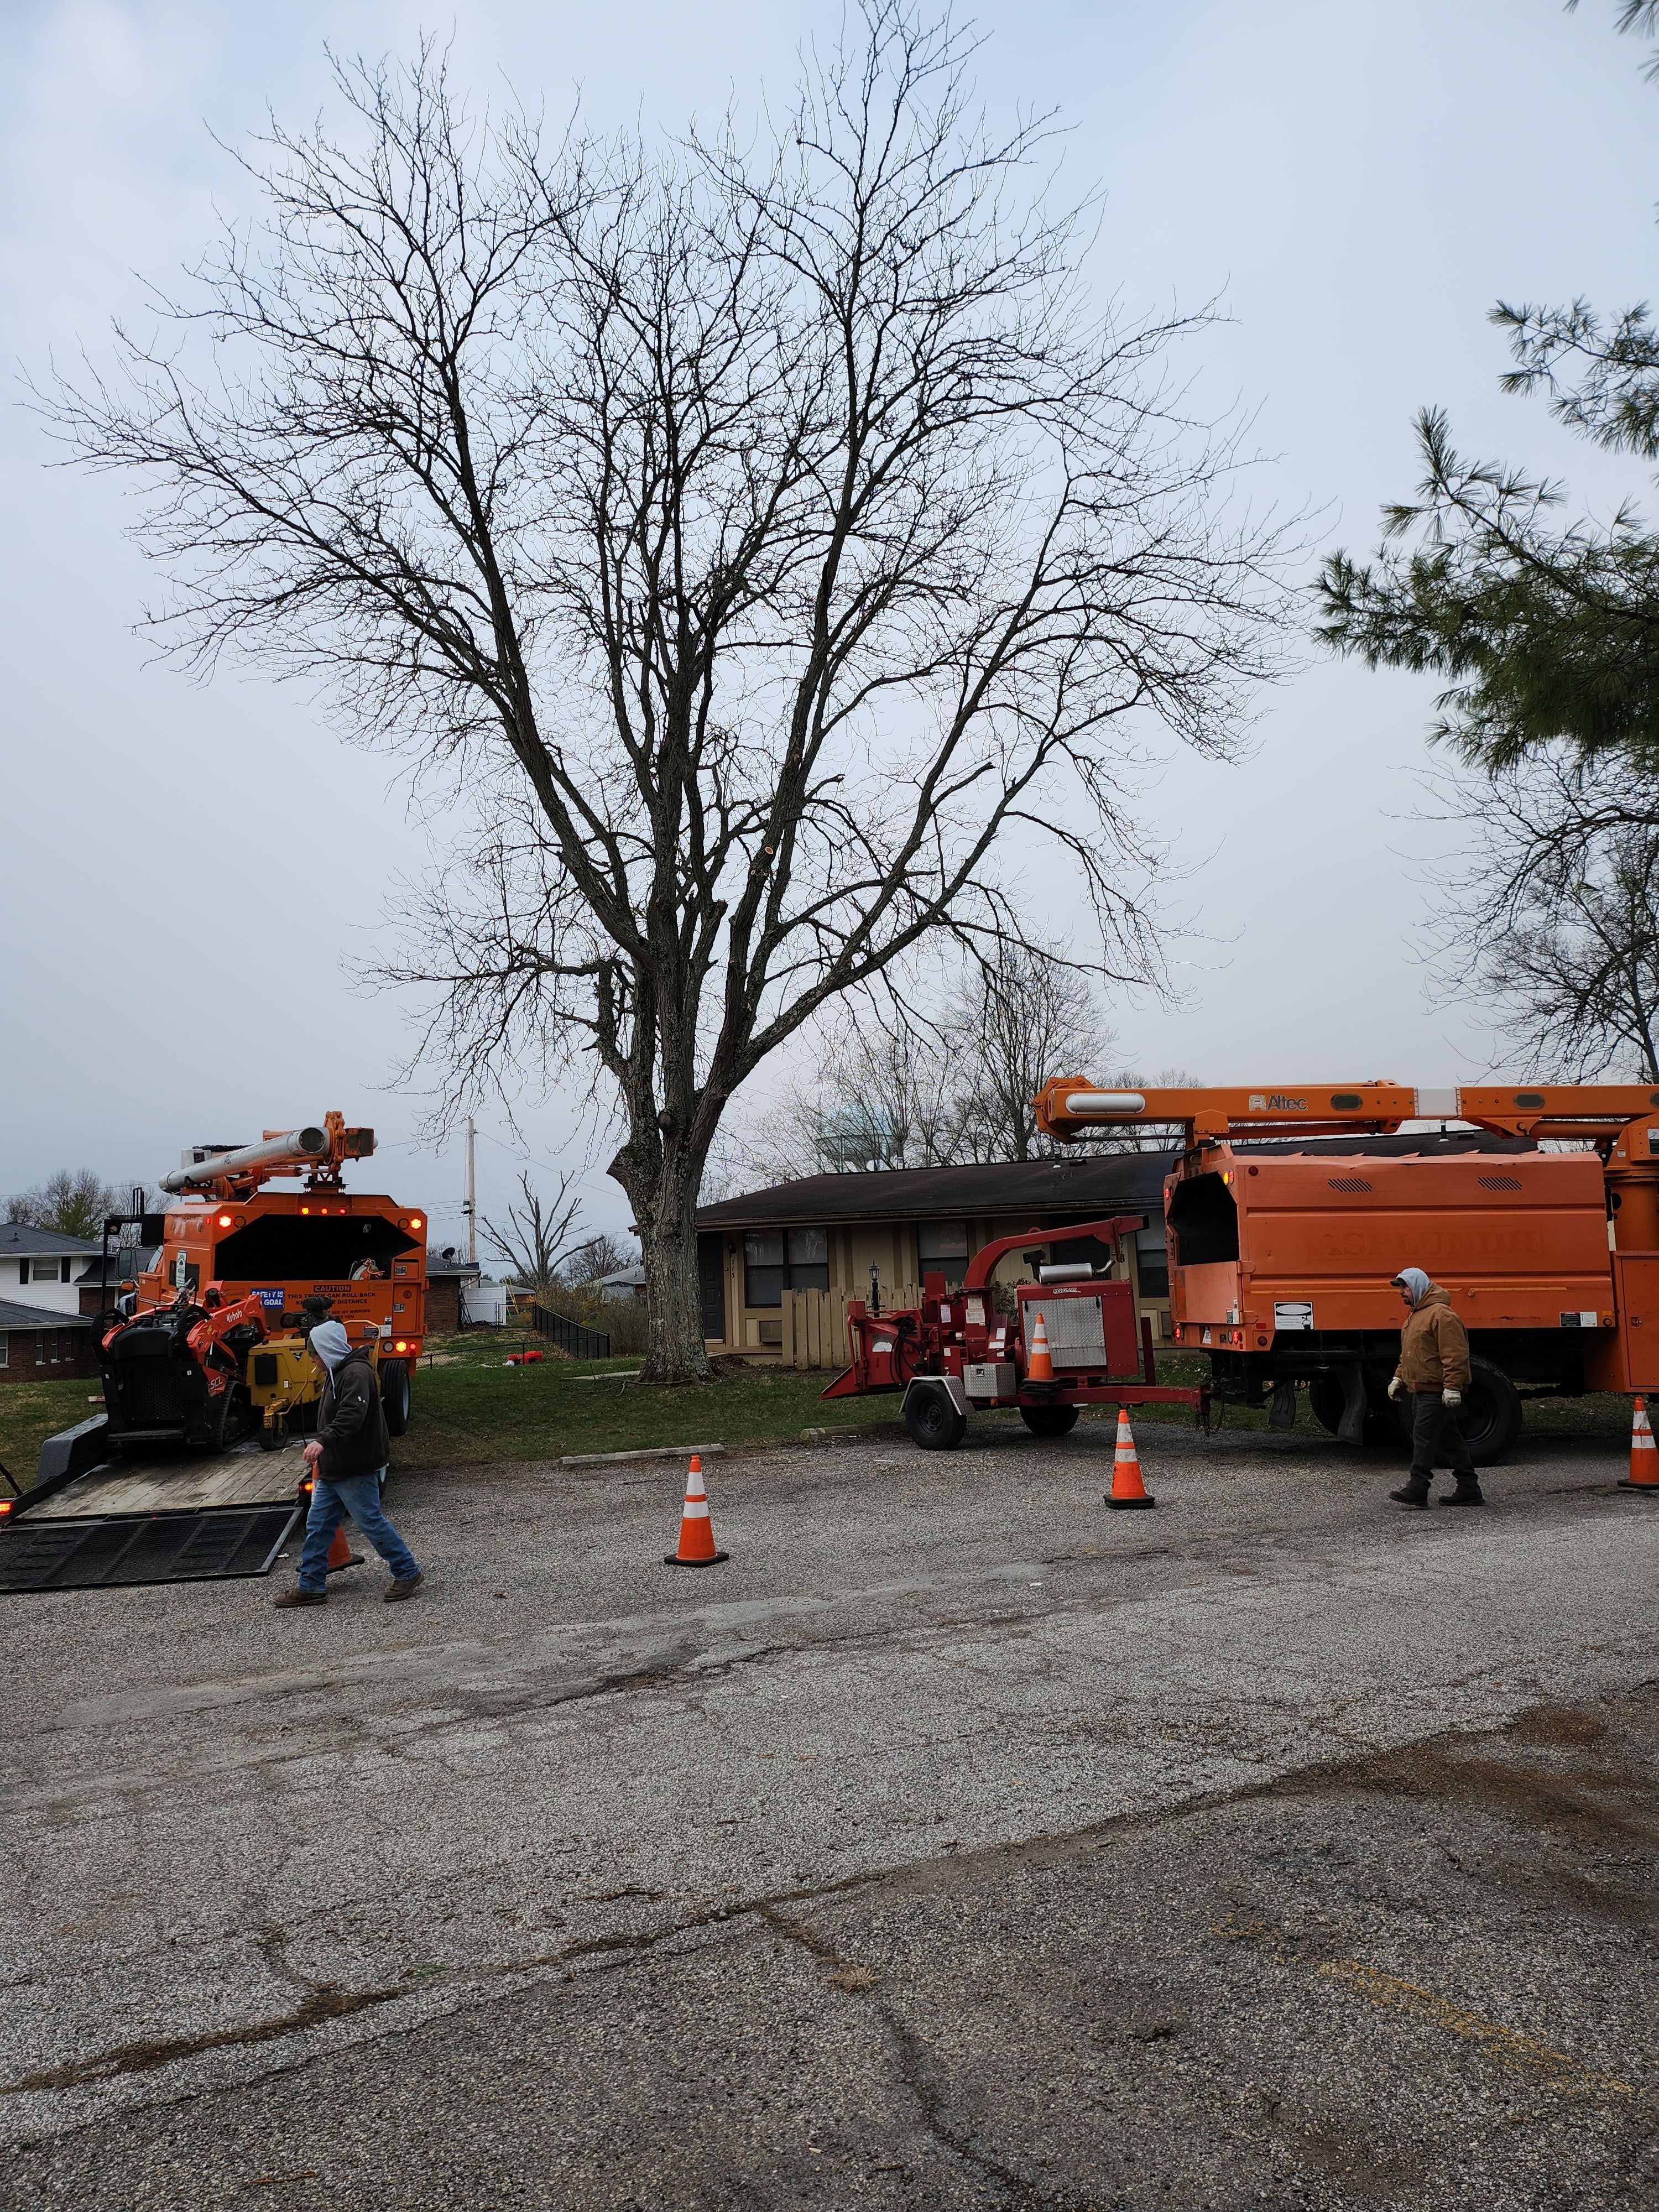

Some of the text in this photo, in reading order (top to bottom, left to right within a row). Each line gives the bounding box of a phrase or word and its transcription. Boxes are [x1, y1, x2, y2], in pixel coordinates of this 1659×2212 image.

[1267, 1094, 1308, 1111] Altec
[226, 1308, 242, 1322] Kubota
[210, 1376, 223, 1390] SCL
